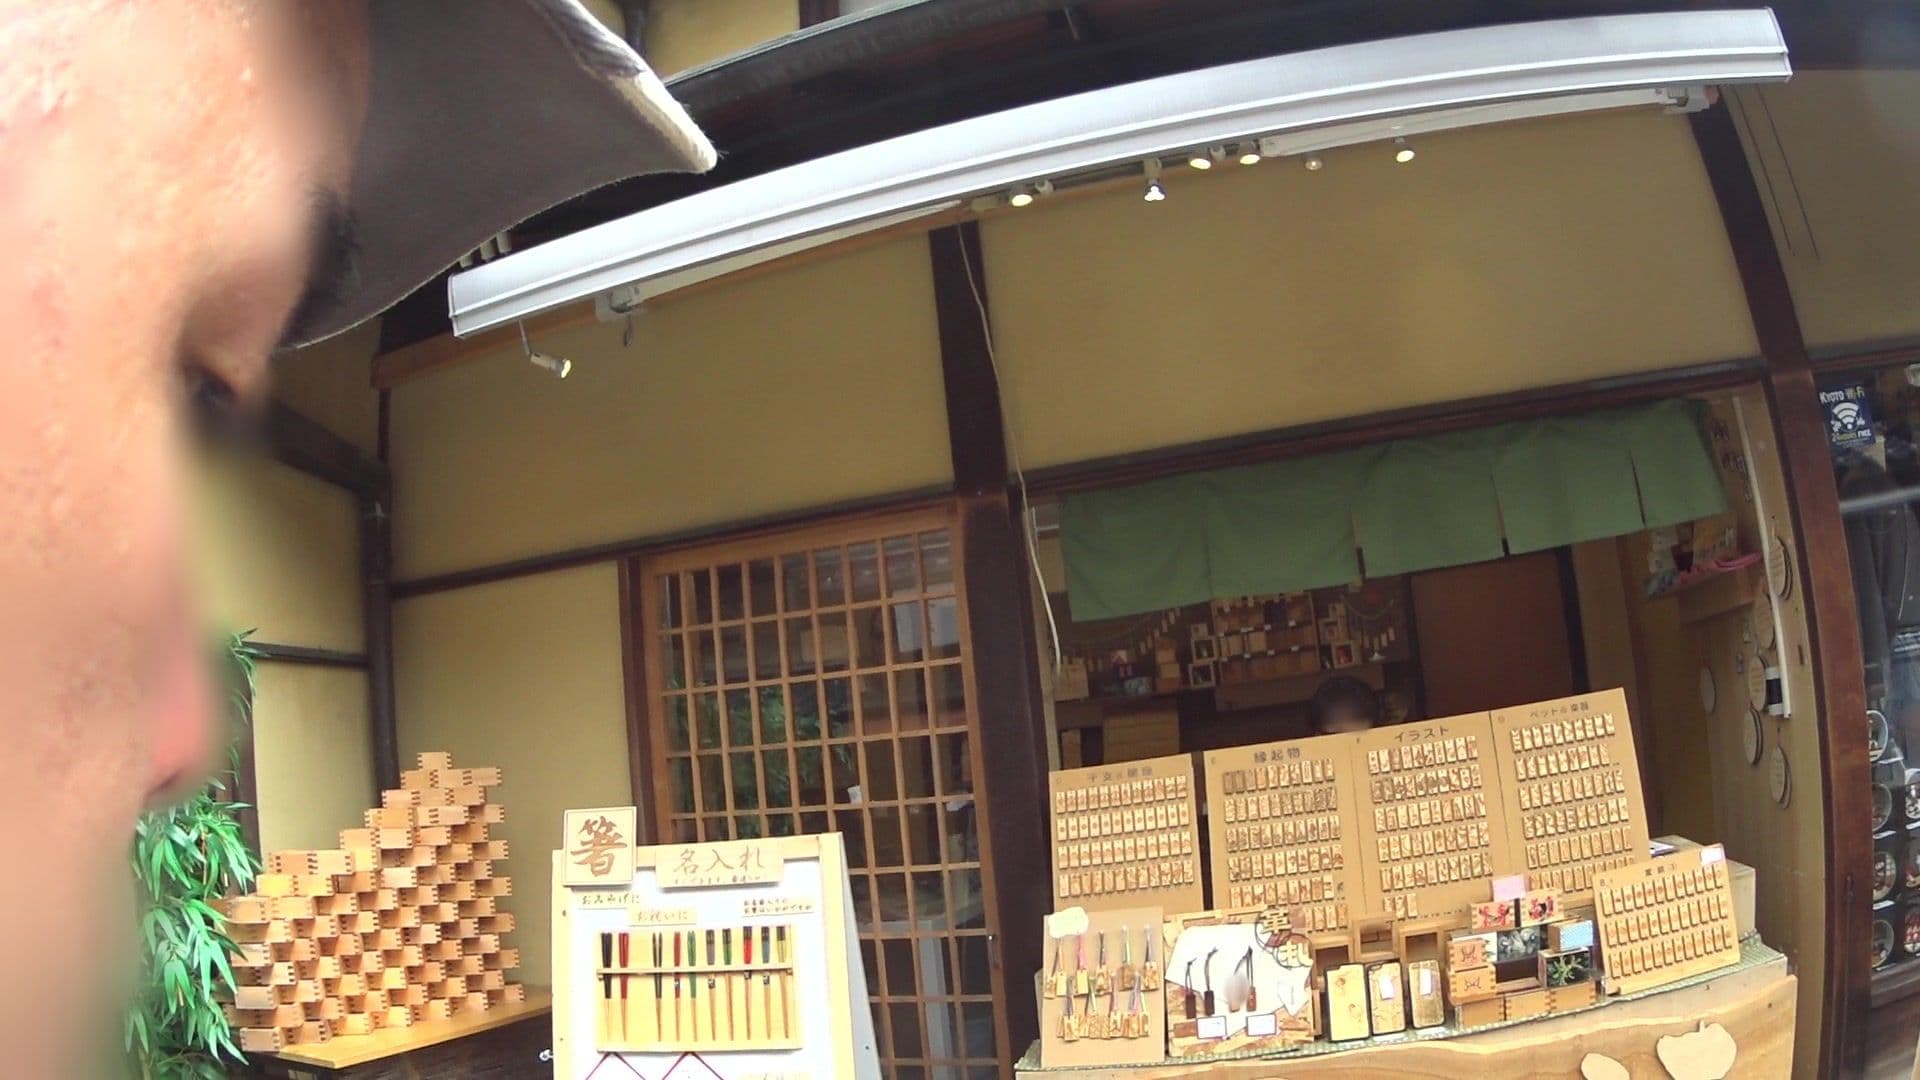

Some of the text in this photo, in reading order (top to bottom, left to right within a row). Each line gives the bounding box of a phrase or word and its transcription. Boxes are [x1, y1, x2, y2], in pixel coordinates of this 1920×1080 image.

[1394, 725, 1449, 743] イラスト
[570, 815, 628, 877] 箸
